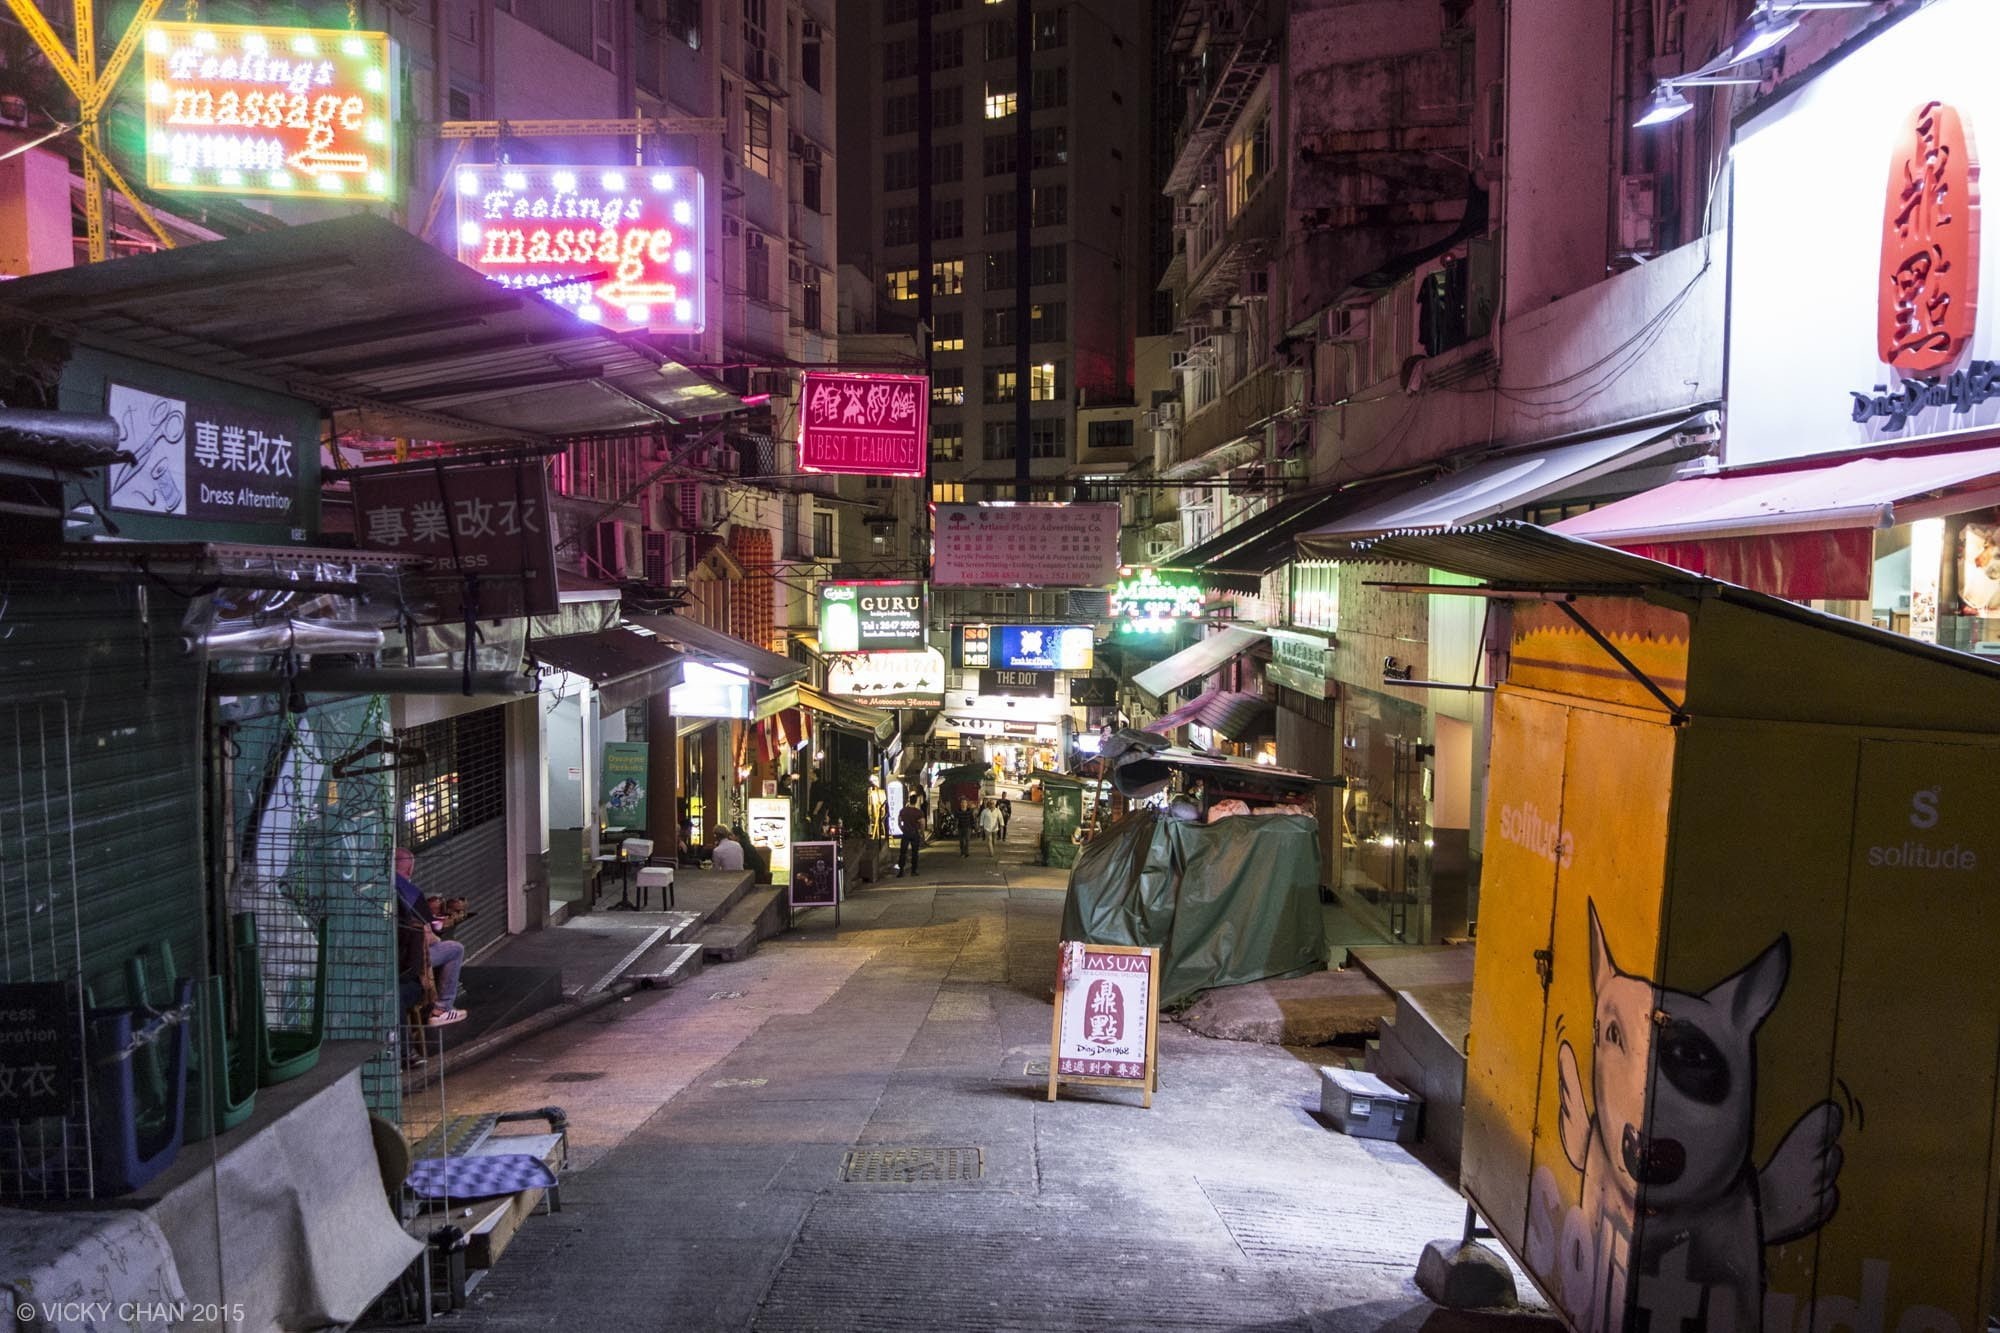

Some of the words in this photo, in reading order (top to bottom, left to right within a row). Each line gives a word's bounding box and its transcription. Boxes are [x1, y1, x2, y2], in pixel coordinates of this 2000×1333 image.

[170, 47, 335, 93] Feelings
[167, 88, 364, 152] massage
[482, 189, 643, 229] Feelings
[479, 227, 673, 283] massage
[194, 420, 293, 478] 專業改衣
[200, 483, 235, 506] Dress
[238, 485, 291, 514] Alteration
[366, 497, 541, 546] 專業改衣
[860, 597, 919, 611] GURU
[996, 671, 1016, 685] THE
[1018, 672, 1038, 686] DOT
[1910, 790, 1939, 829] S
[1501, 801, 1574, 870] solitude
[1868, 841, 1978, 870] solitude
[1082, 955, 1147, 972] IMSUM
[0, 1008, 36, 1022] ress
[1088, 981, 1118, 1043] 鼎點
[1076, 1044, 1096, 1056] Ding
